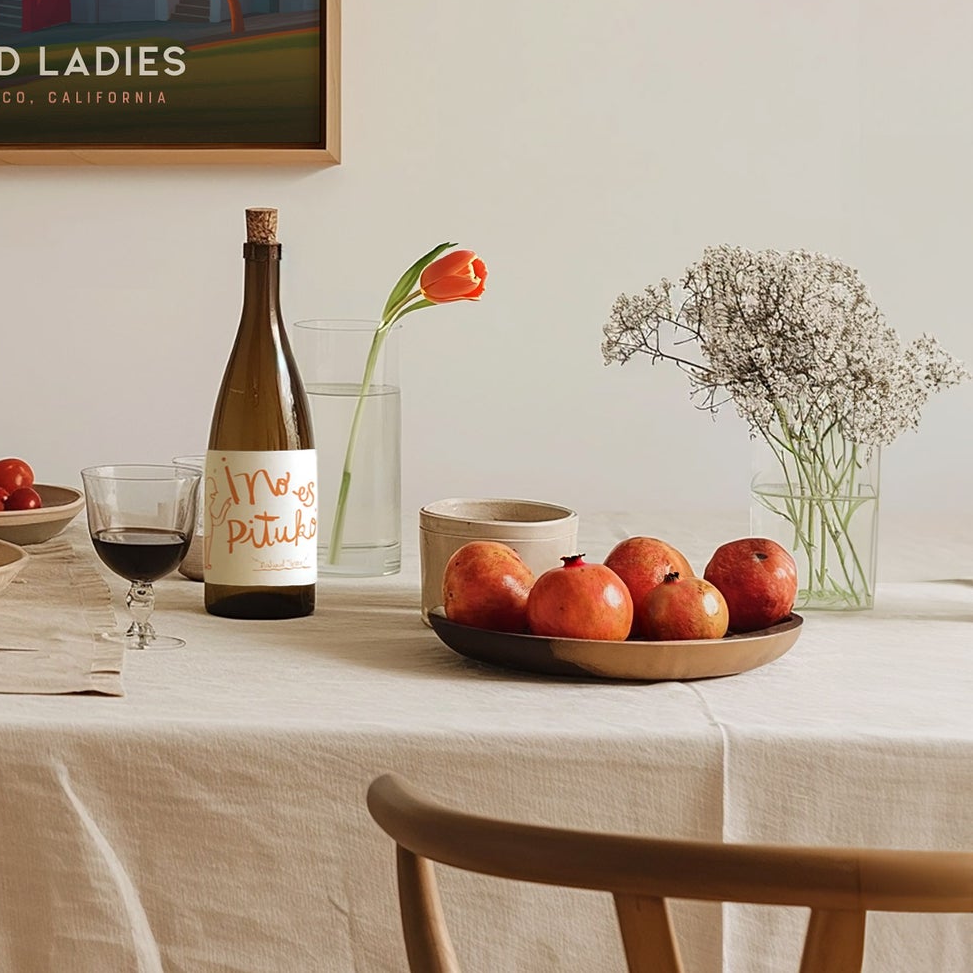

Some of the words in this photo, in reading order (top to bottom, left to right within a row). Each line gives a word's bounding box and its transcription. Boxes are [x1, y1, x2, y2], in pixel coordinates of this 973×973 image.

[39, 45, 186, 76] LADIES
[48, 90, 167, 104] CALIFORNIA
[292, 482, 315, 507] es
